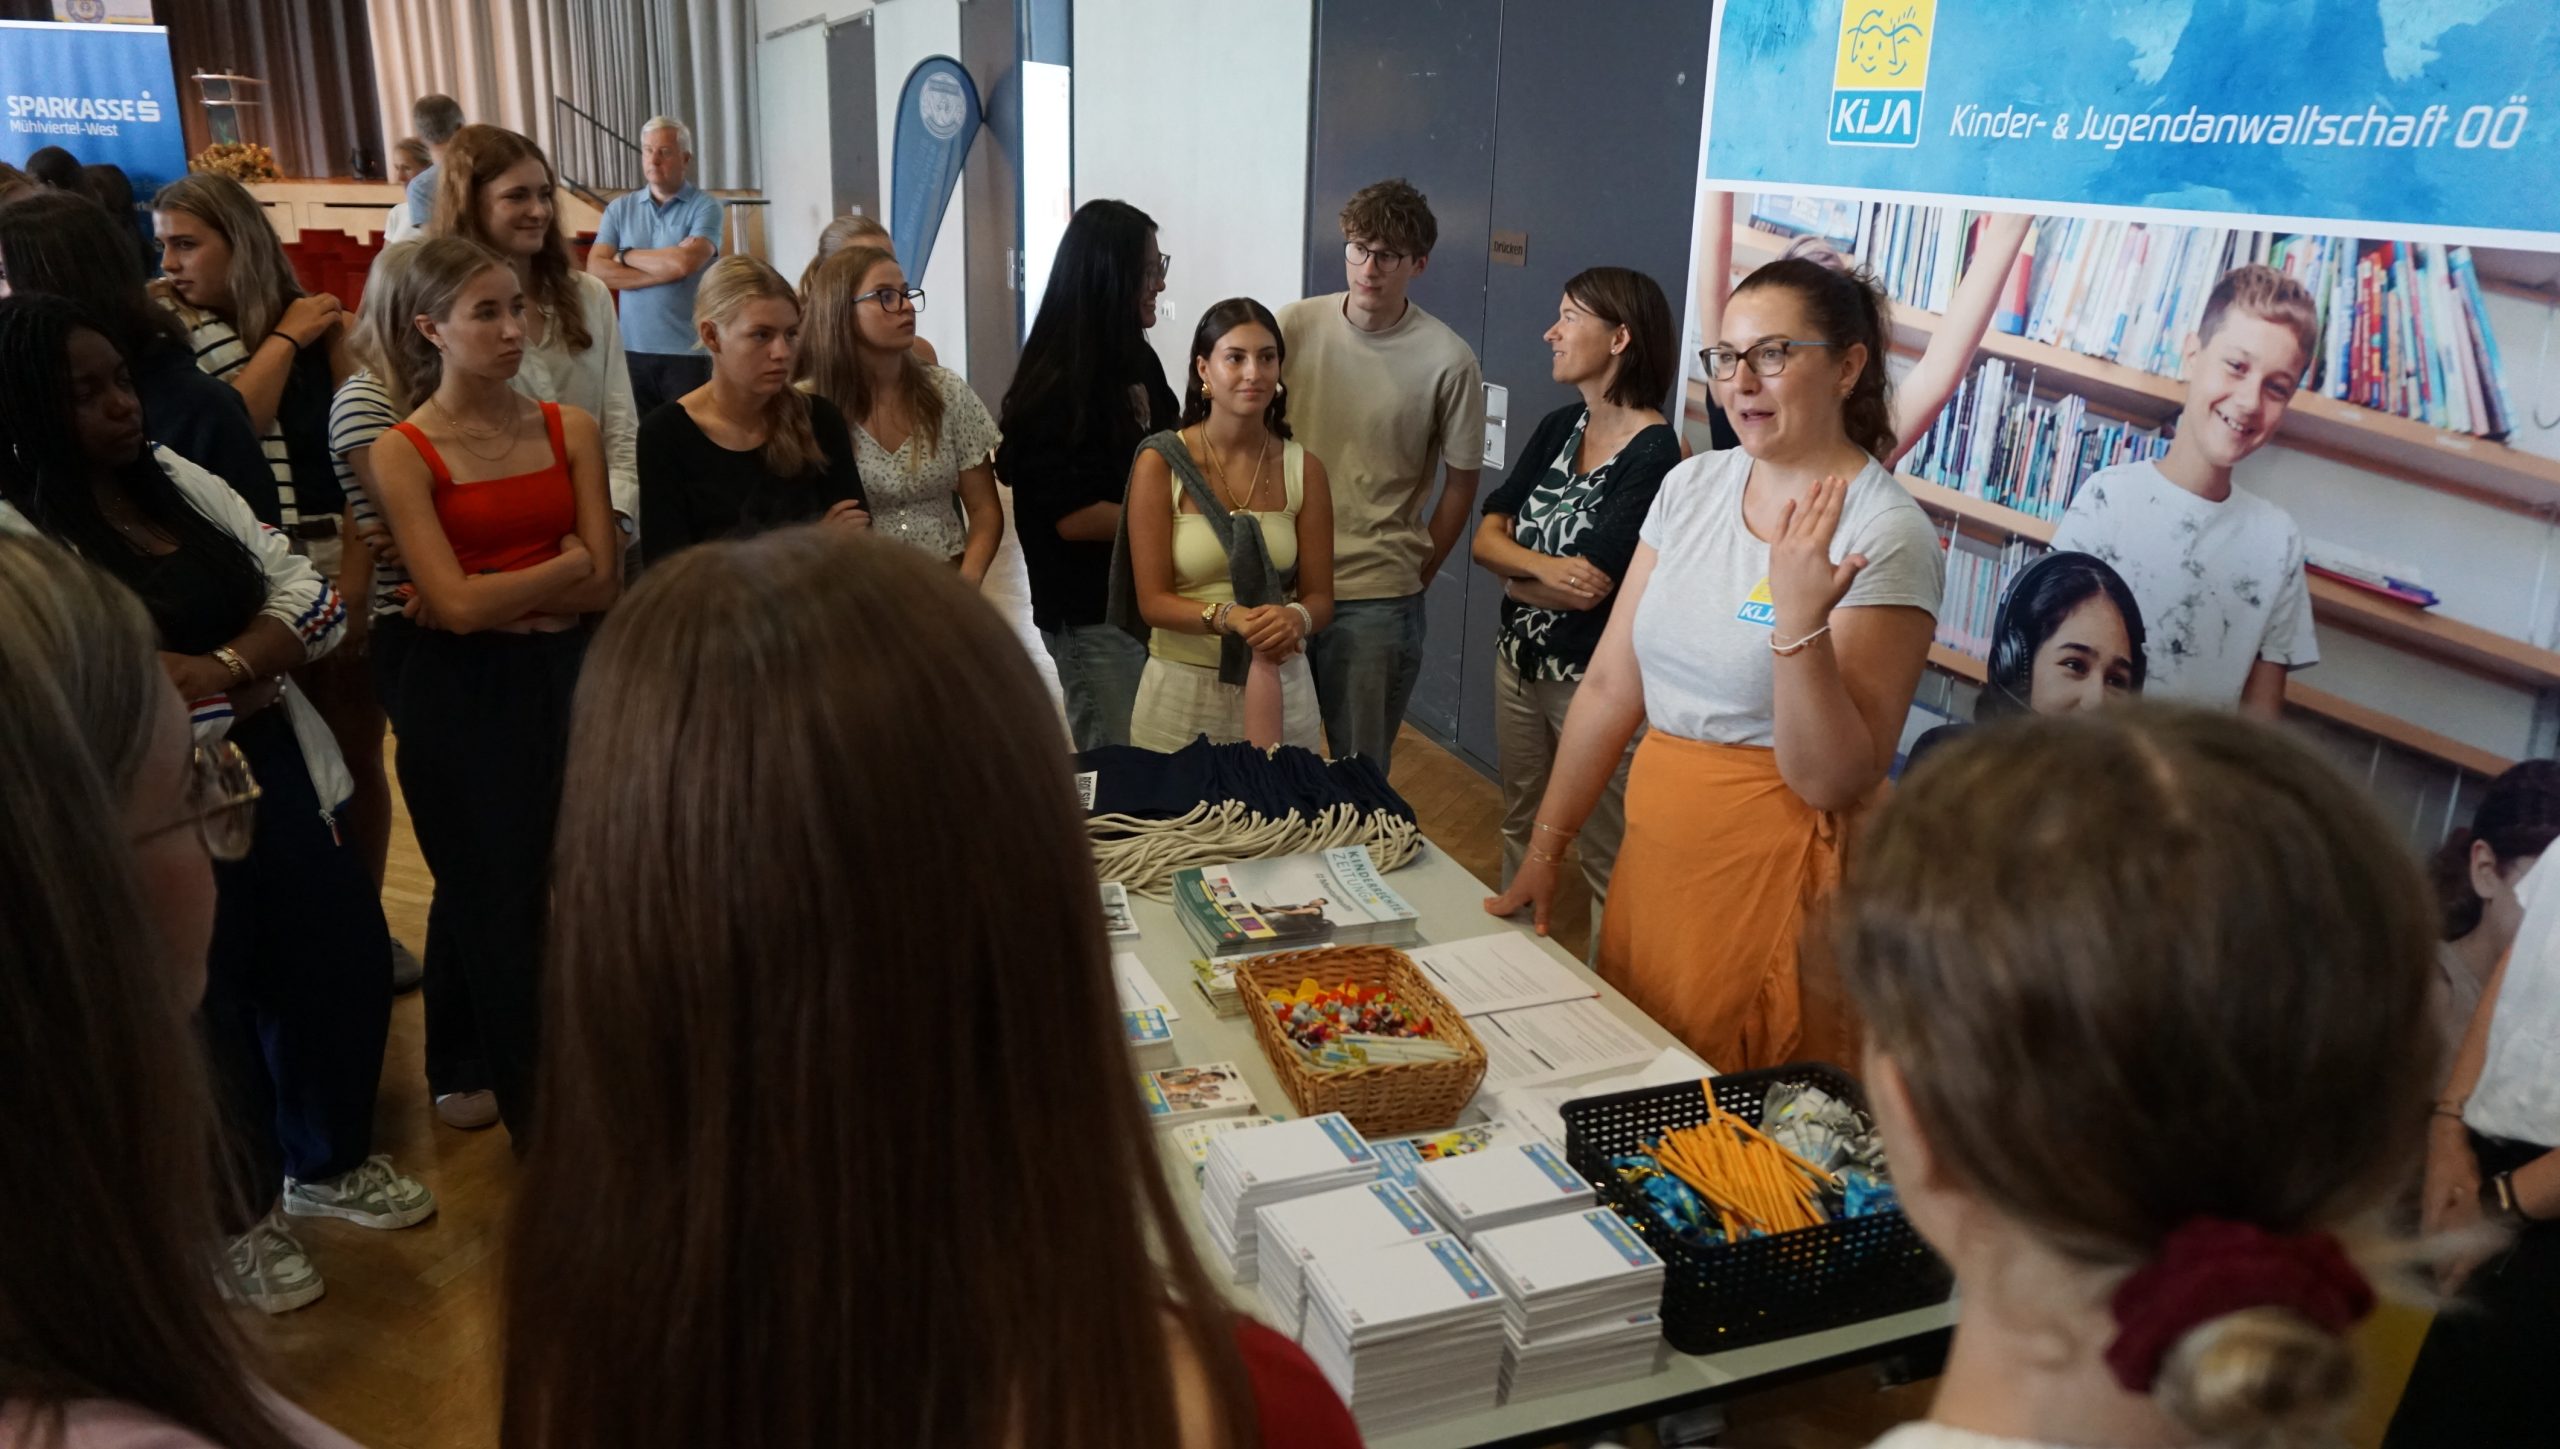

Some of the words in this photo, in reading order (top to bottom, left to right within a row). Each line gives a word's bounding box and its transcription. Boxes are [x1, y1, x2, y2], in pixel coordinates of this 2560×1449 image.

[6, 95, 136, 122] SPARKASSE
[10, 119, 119, 137] Mühlviertel-West
[1949, 103, 2047, 139] Kinder-
[2052, 113, 2069, 140] &
[2076, 104, 2449, 150] Jugendanwaltschaft
[2454, 95, 2528, 149] OÖ
[1493, 240, 1524, 256] Drücken
[1332, 852, 1371, 899] ZEITUNG
